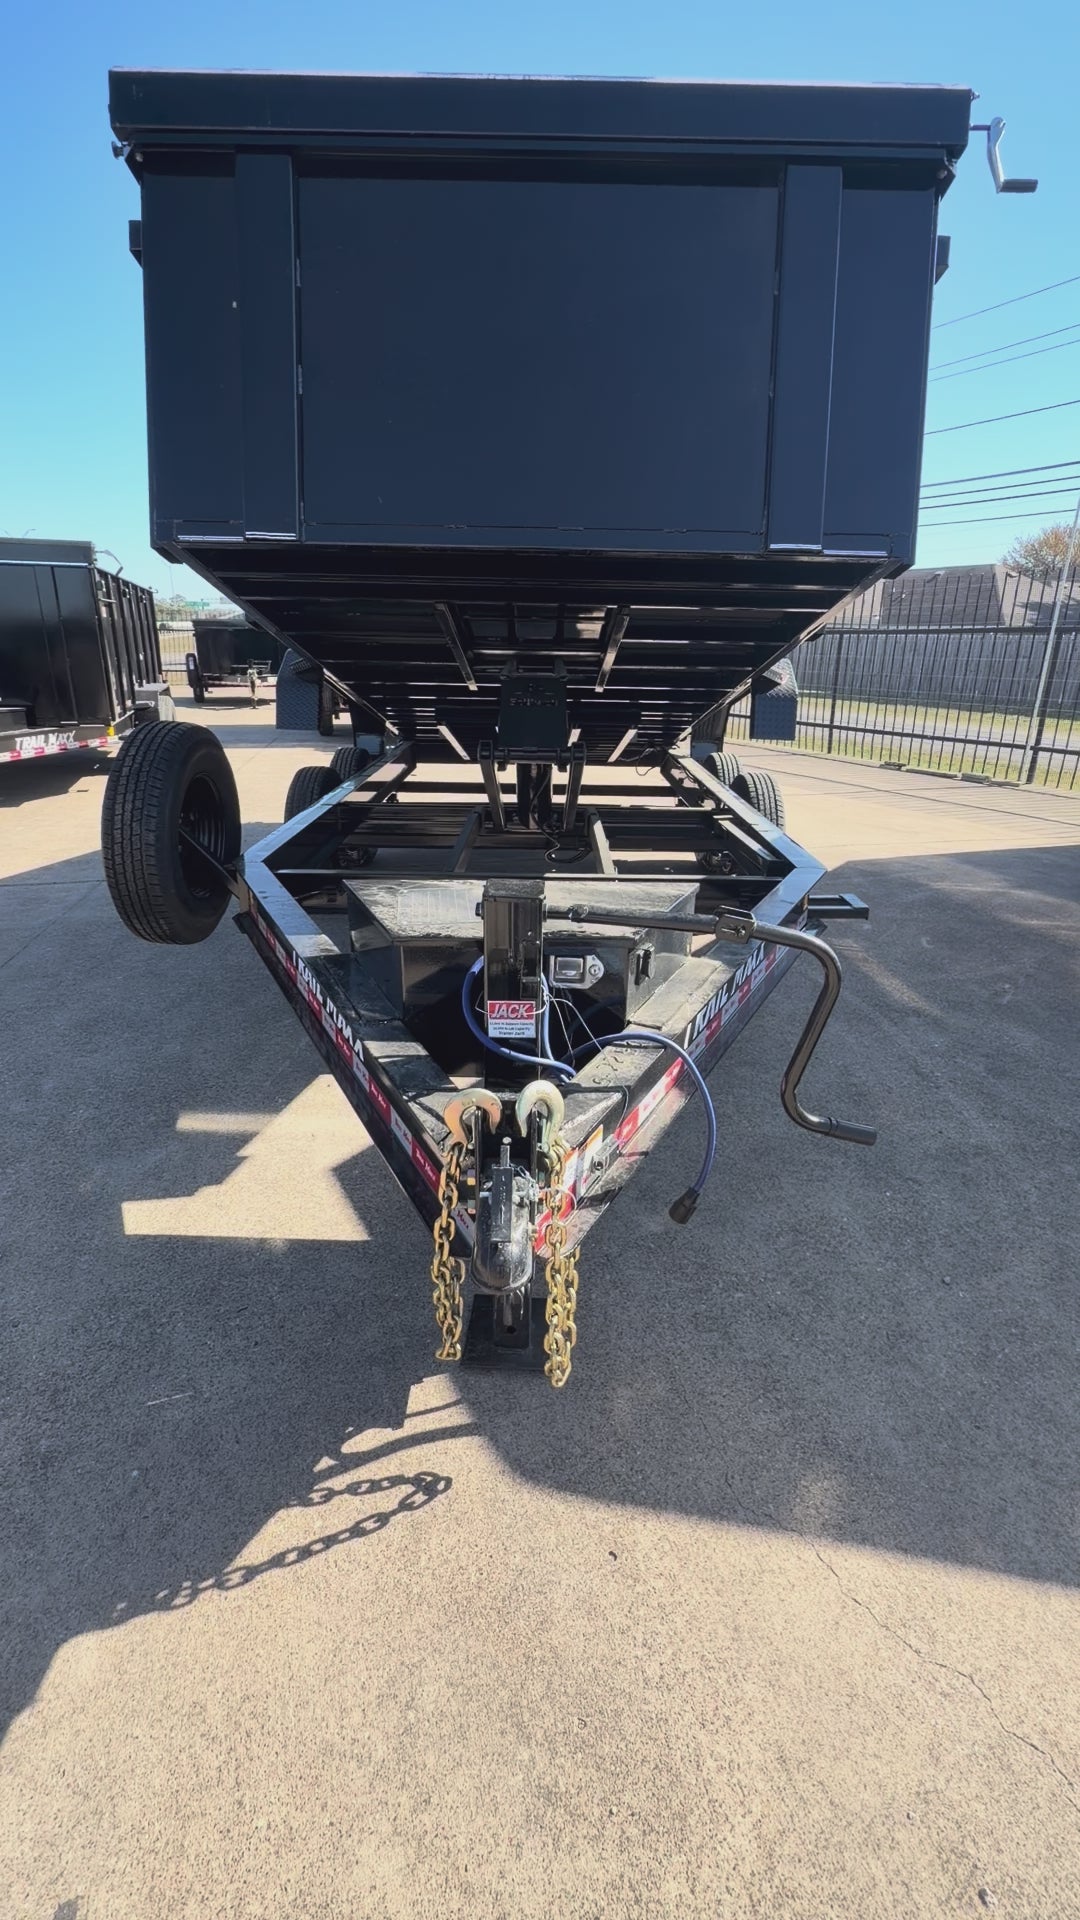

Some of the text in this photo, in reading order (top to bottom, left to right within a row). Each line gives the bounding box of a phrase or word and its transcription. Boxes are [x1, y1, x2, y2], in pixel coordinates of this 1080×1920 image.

[14, 734, 47, 750] TRAIL
[48, 730, 76, 746] MAXX
[491, 1003, 532, 1018] JACK
